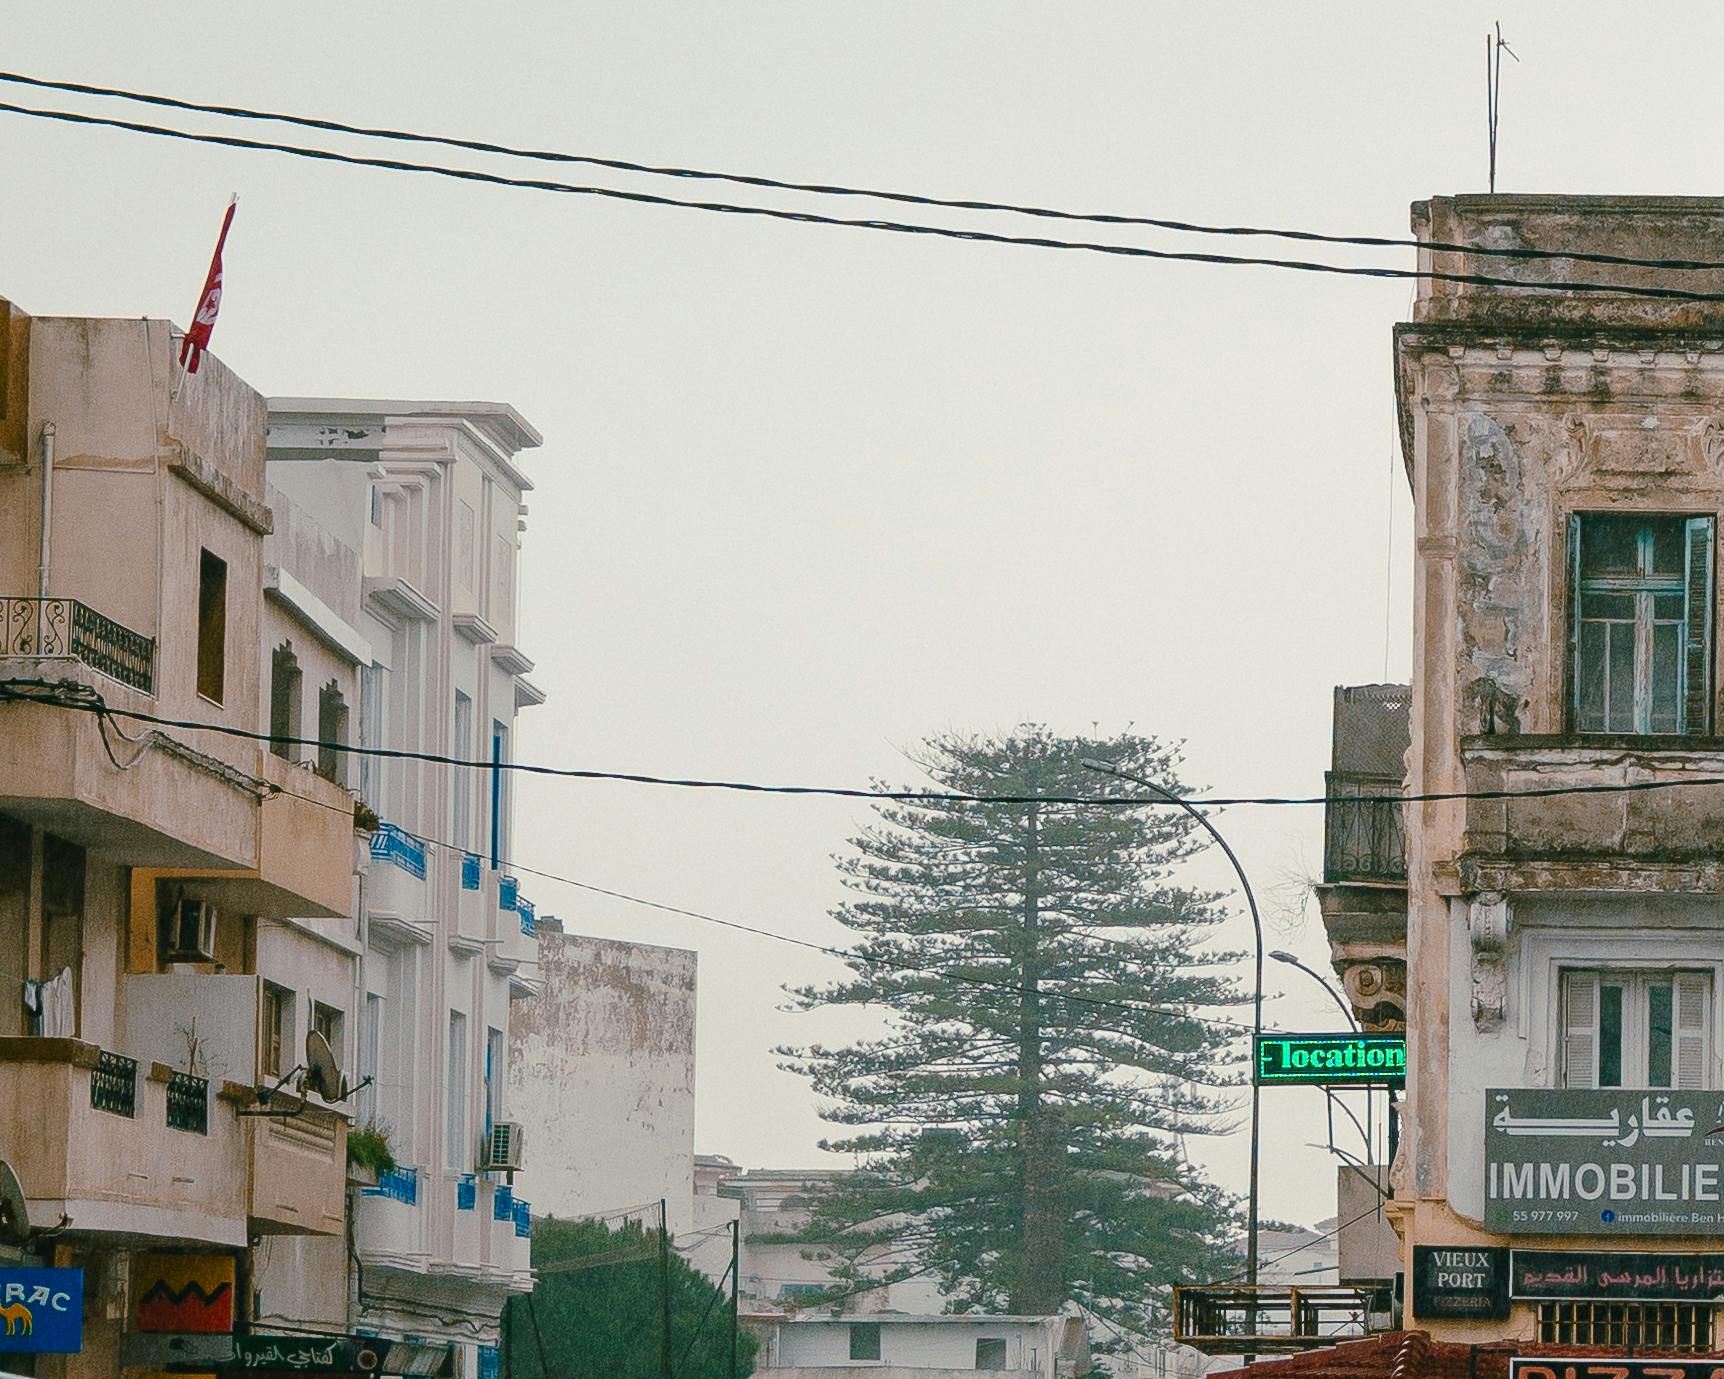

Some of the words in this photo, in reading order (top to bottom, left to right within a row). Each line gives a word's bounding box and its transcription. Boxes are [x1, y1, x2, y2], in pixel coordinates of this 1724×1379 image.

[1281, 1041, 1405, 1068] location
[1493, 1094, 1696, 1148] عقارية
[1704, 1138, 1724, 1147] BEN
[1512, 1211, 1528, 1222] 55
[1530, 1211, 1554, 1222] 977
[1556, 1211, 1579, 1222] 997
[1618, 1212, 1689, 1224] immobilière
[1692, 1212, 1715, 1224] Ben
[1432, 1251, 1489, 1268] VIEUX
[1437, 1272, 1486, 1288] PORT
[0, 1283, 71, 1312] RAC
